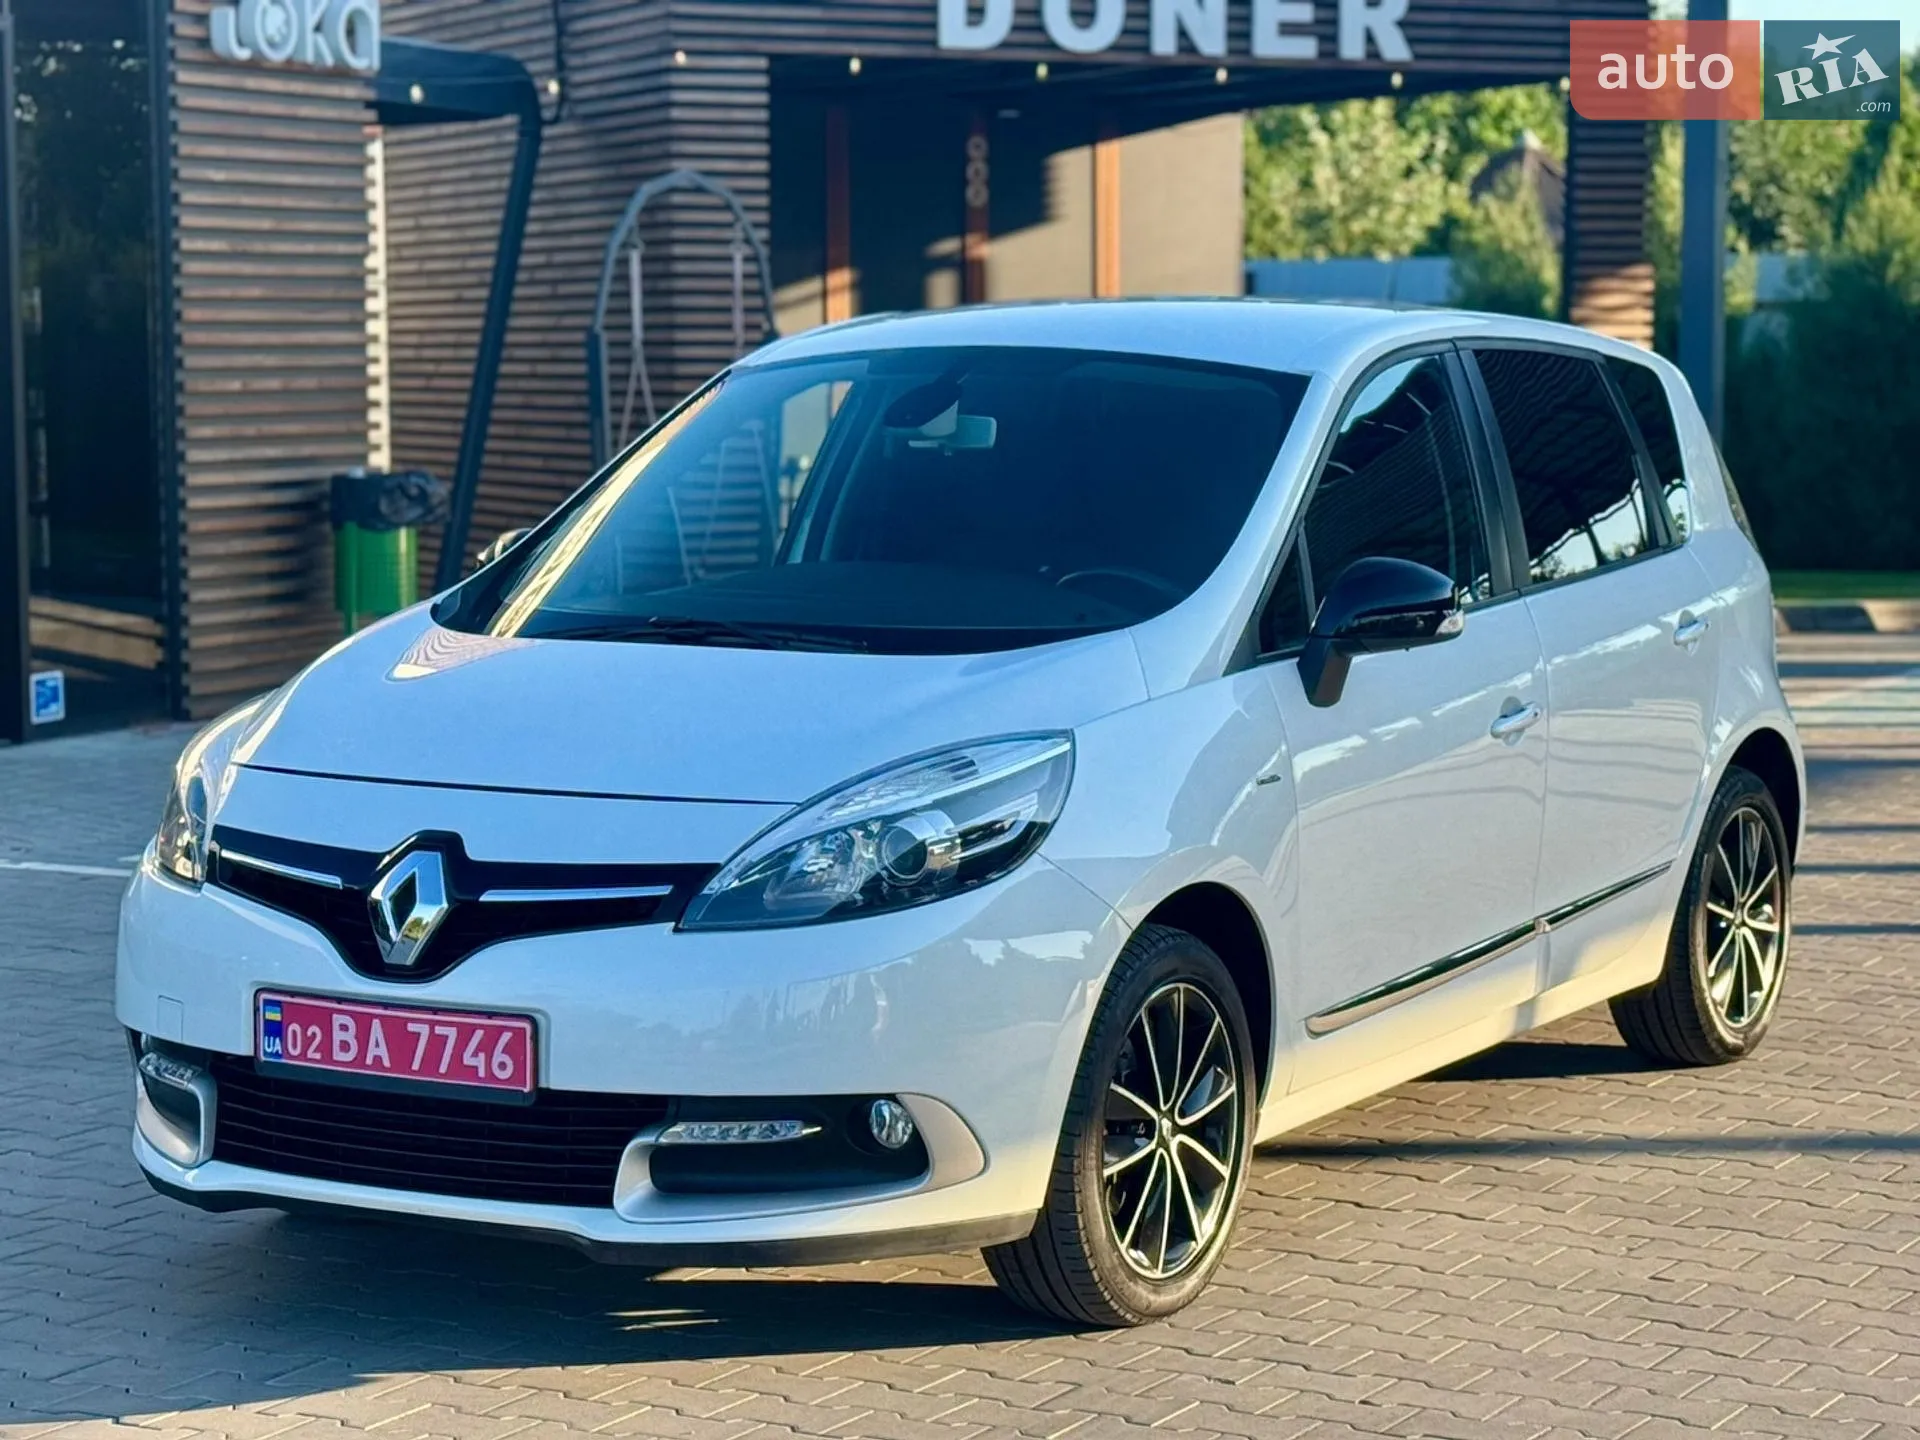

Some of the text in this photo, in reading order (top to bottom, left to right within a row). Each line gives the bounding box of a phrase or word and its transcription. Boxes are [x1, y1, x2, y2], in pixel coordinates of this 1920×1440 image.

[264, 1035, 283, 1055] UA
[286, 1013, 515, 1080] 02 BA 7746
